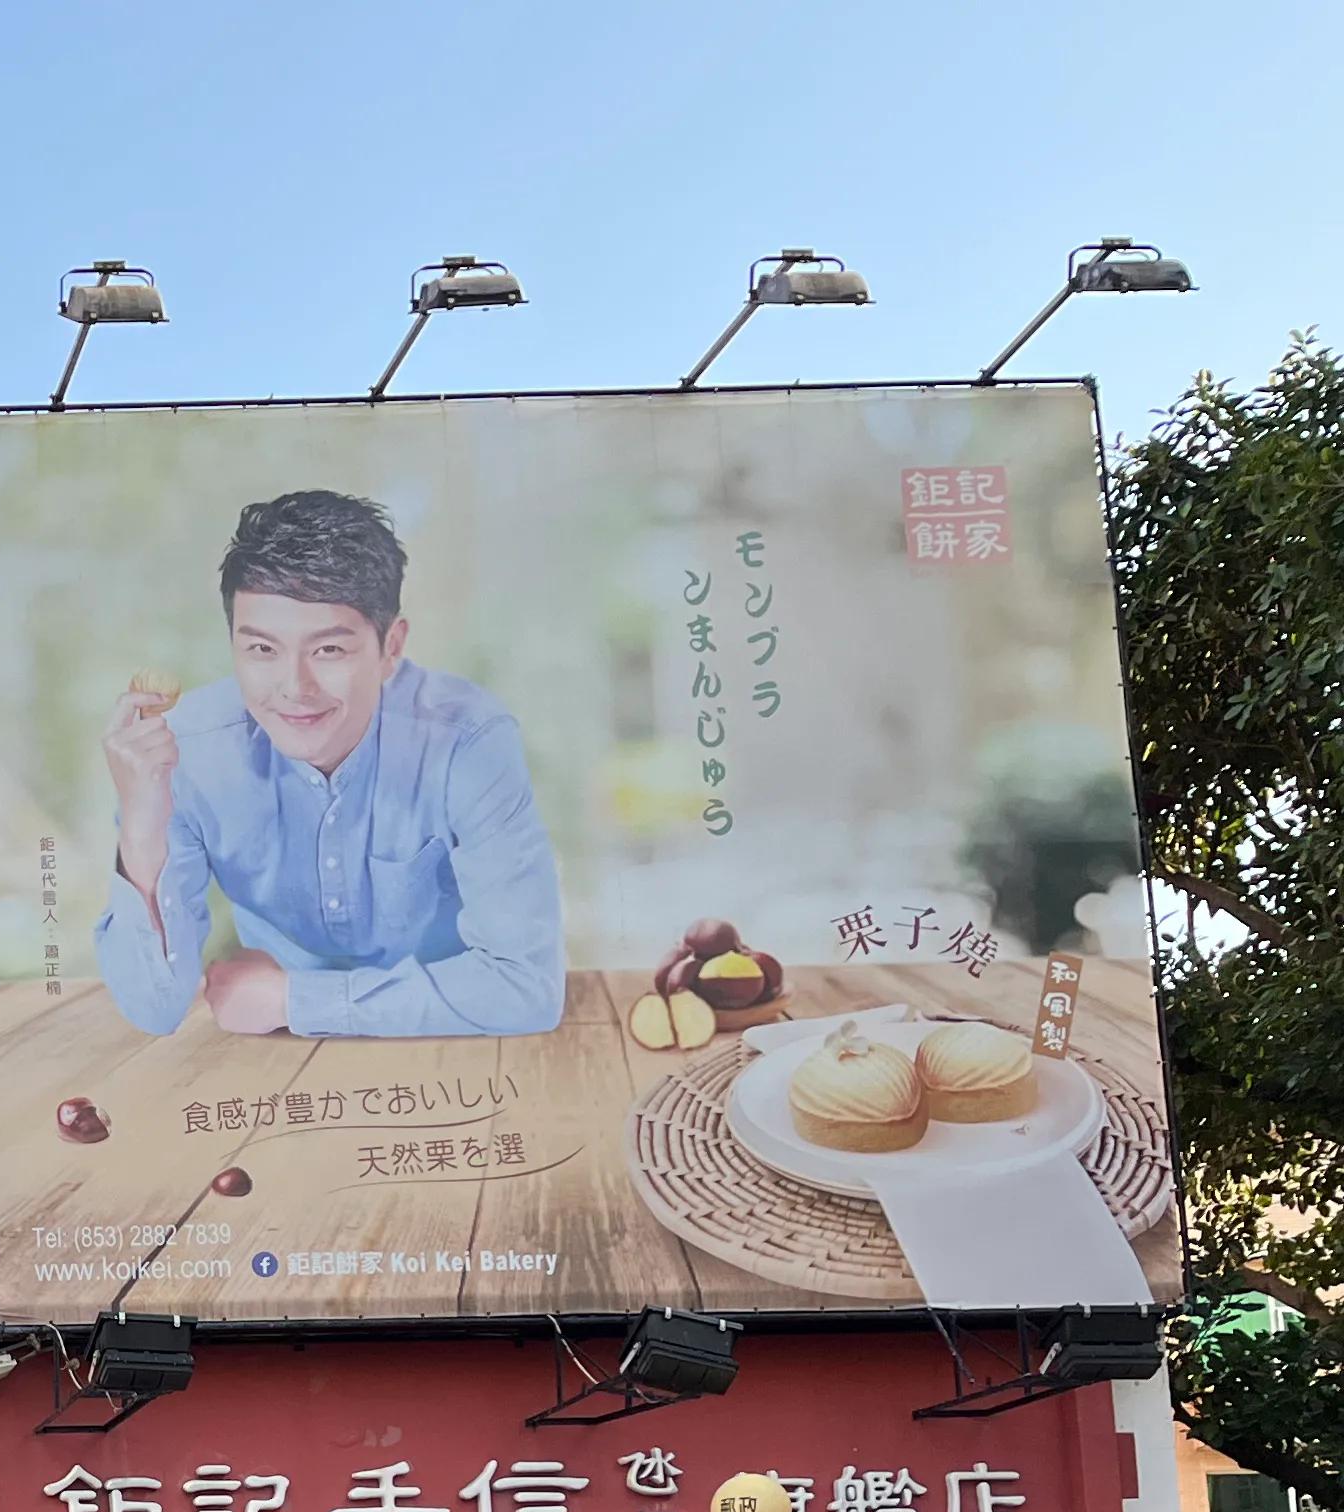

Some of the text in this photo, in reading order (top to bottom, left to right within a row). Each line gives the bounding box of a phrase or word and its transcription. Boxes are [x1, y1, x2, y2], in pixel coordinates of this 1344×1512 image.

[906, 470, 1004, 508] 鉅記
[911, 520, 1009, 559] 餅家
[735, 531, 781, 719] モンブラ
[683, 569, 734, 837] ンまんじゅう
[830, 904, 999, 979] 栗子燒
[1043, 961, 1079, 1051] 和風製
[182, 1074, 519, 1135] 食感が豊かでおいしい
[357, 1132, 527, 1178] 天然栗を選
[32, 1223, 232, 1252] Tel: (853) 2882 7839
[34, 1255, 232, 1282] www.koikei.com
[286, 1248, 558, 1276] 鉅記餅家 Koi Kei Bakery
